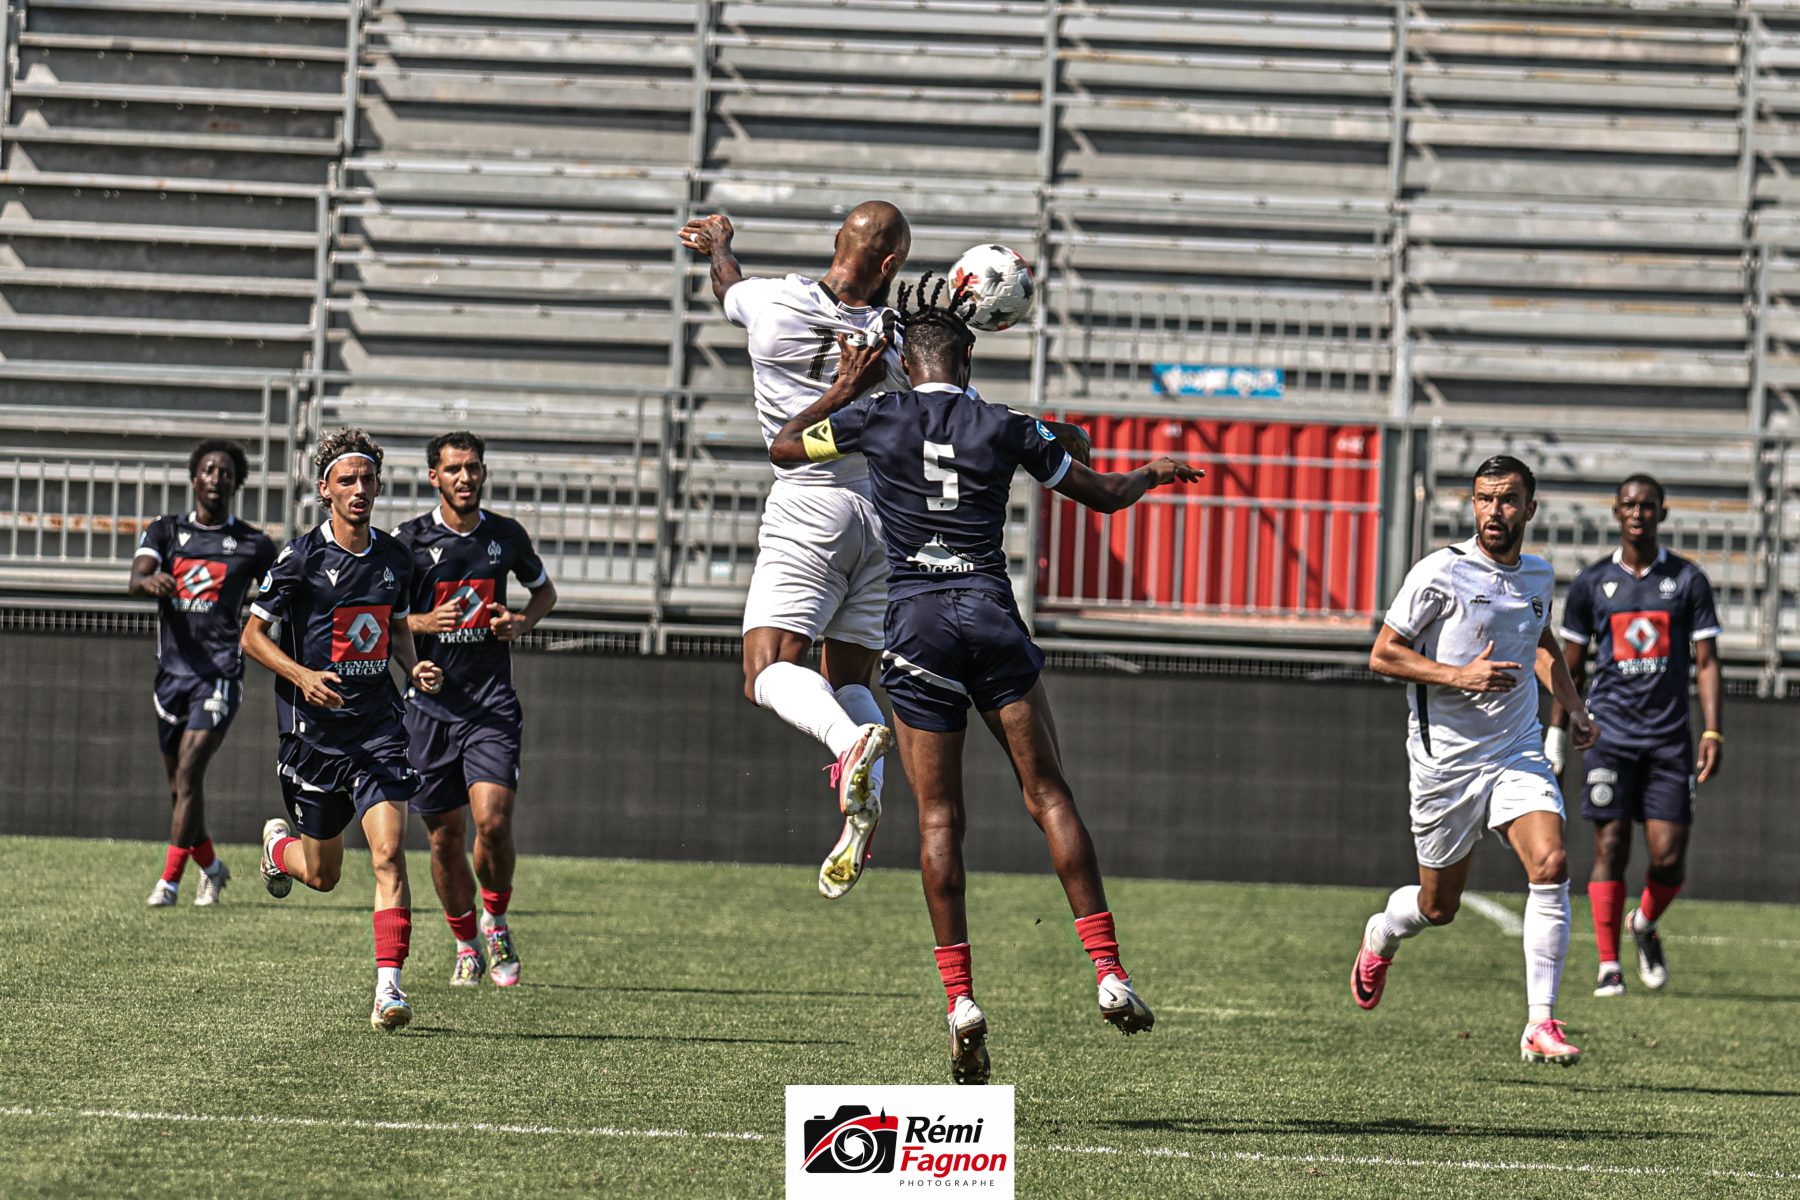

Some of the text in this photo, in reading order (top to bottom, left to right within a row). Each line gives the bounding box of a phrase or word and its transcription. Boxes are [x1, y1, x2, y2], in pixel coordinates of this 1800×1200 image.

[923, 440, 959, 511] 5
[918, 562, 975, 574] Ocean
[334, 659, 388, 669] RENAULT
